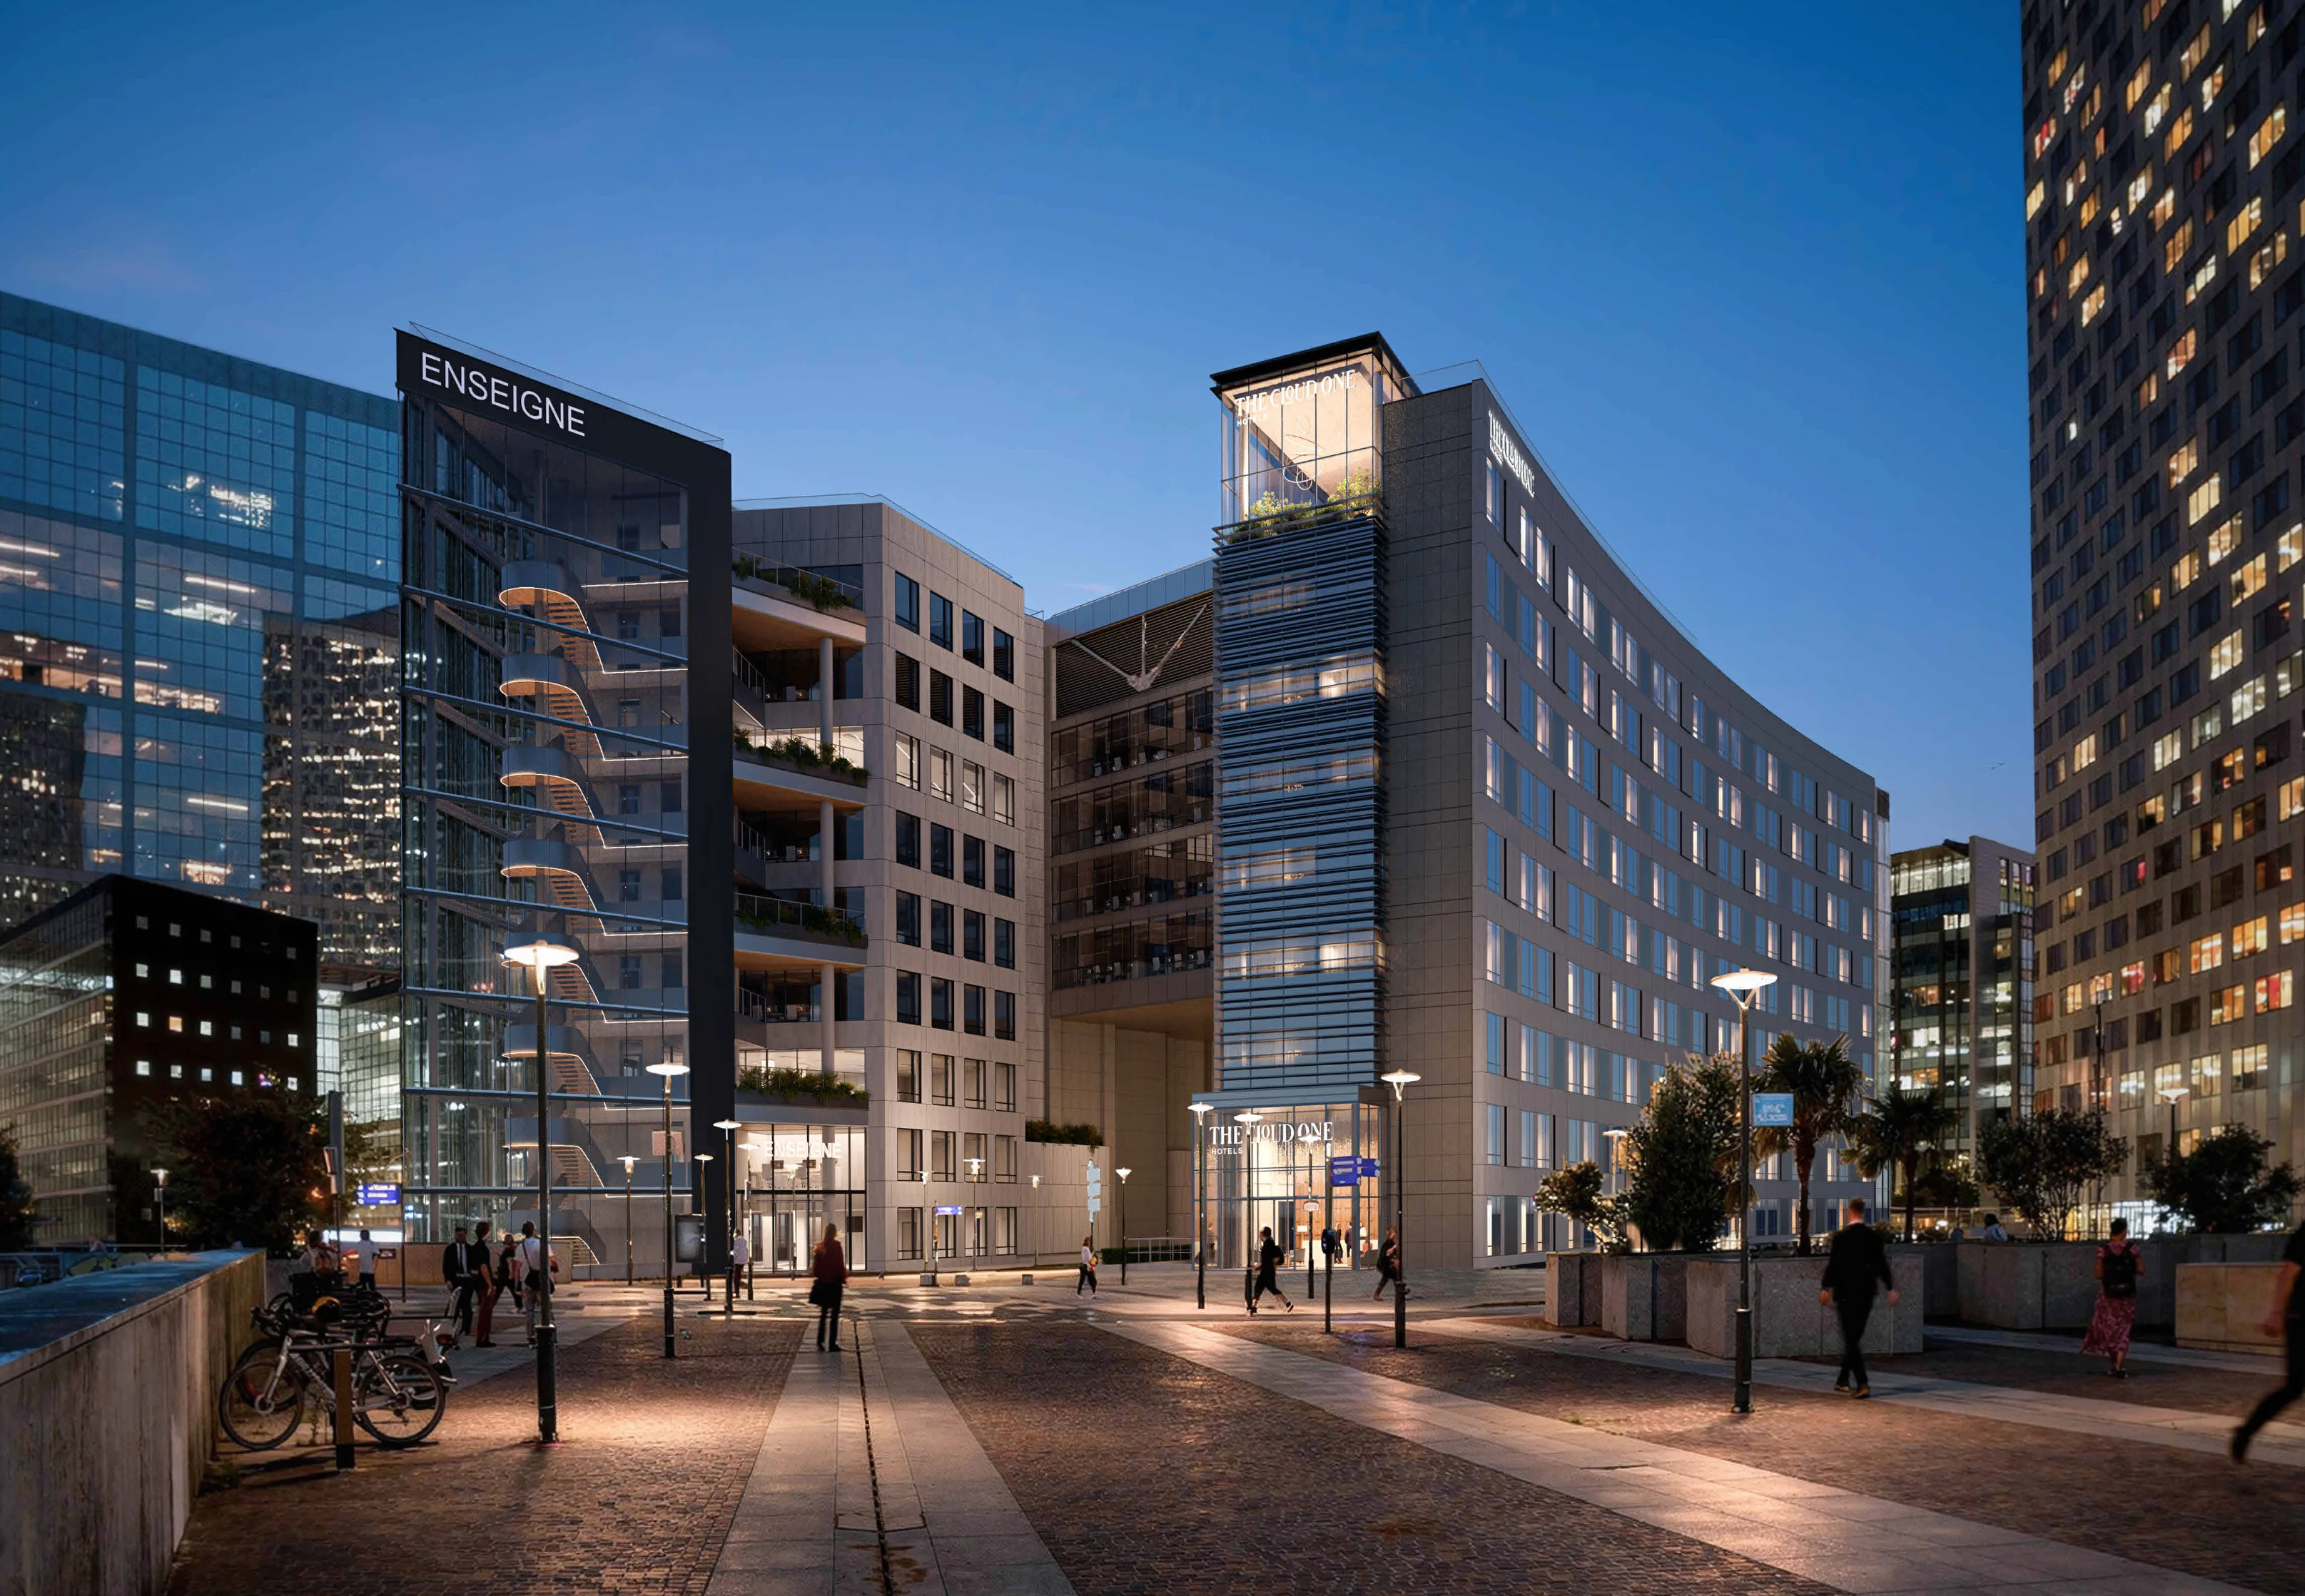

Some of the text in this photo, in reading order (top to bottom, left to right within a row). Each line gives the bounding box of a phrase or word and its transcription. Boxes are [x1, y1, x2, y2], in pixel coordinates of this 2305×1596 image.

[422, 351, 585, 437] ENSEIGNE
[1235, 369, 1356, 417] THE CLOUD ONE
[764, 1142, 842, 1158] ENSEIGNE
[1209, 1126, 1242, 1144] THE
[1297, 1122, 1333, 1142] ONE
